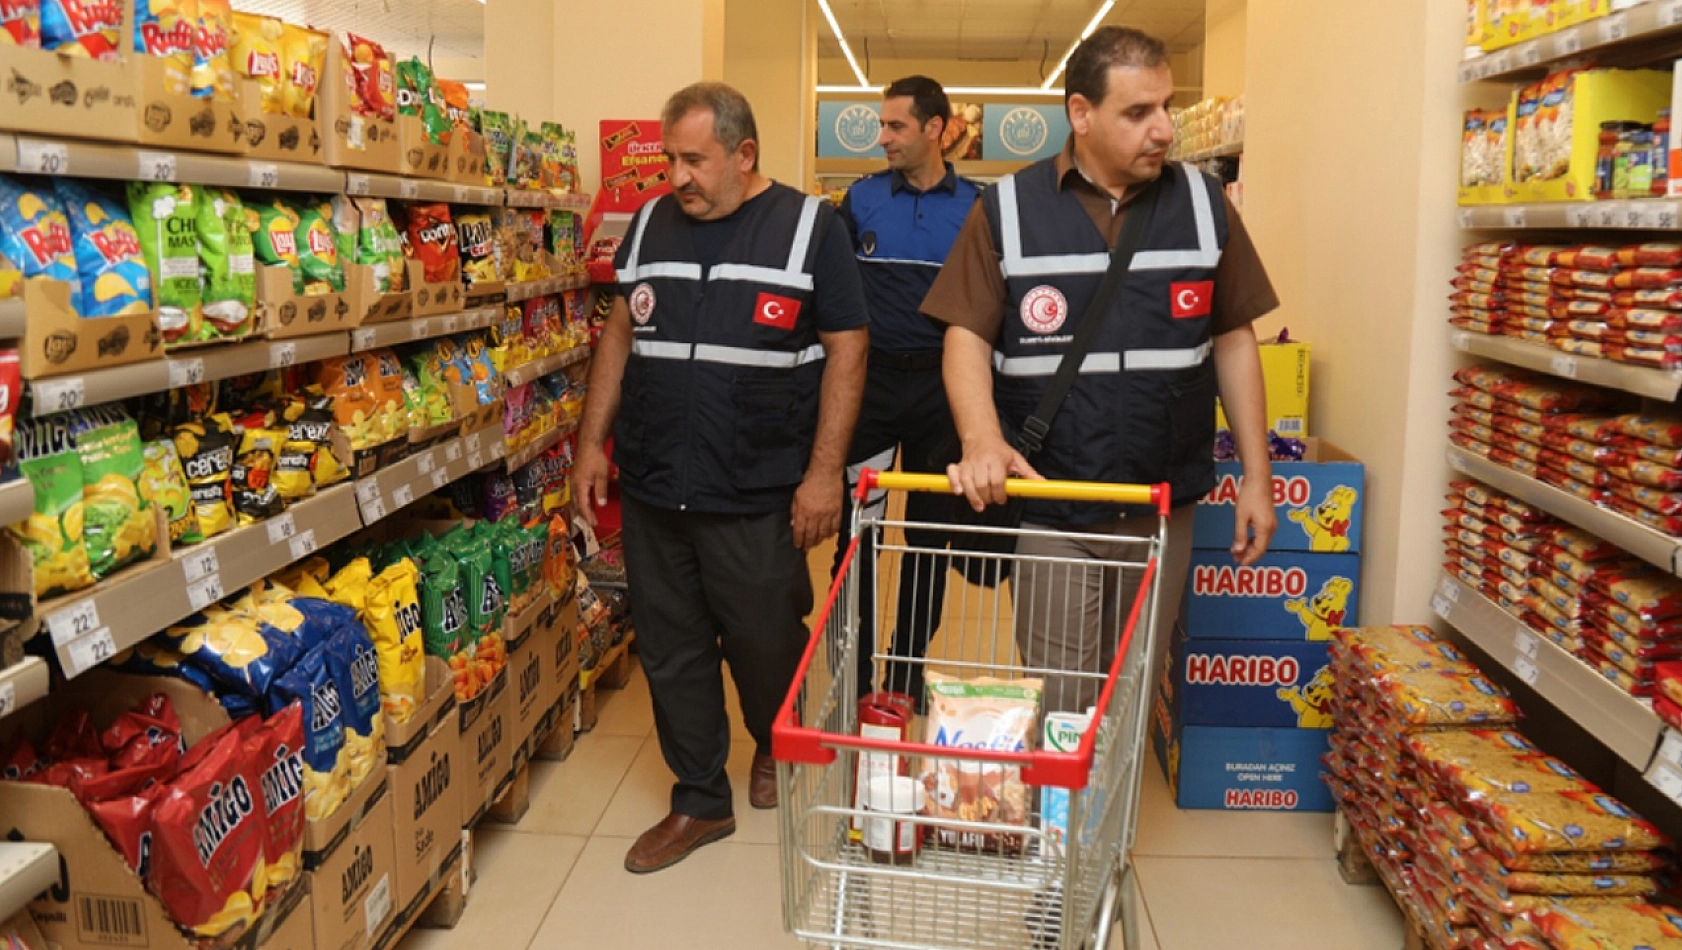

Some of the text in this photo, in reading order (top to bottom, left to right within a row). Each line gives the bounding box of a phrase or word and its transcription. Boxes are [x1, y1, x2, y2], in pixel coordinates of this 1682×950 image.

[1194, 565, 1307, 596] HARIBO
[1186, 654, 1299, 686] HARIBO
[1237, 773, 1283, 782] OPEN HERE
[1224, 787, 1299, 810] HARIBO
